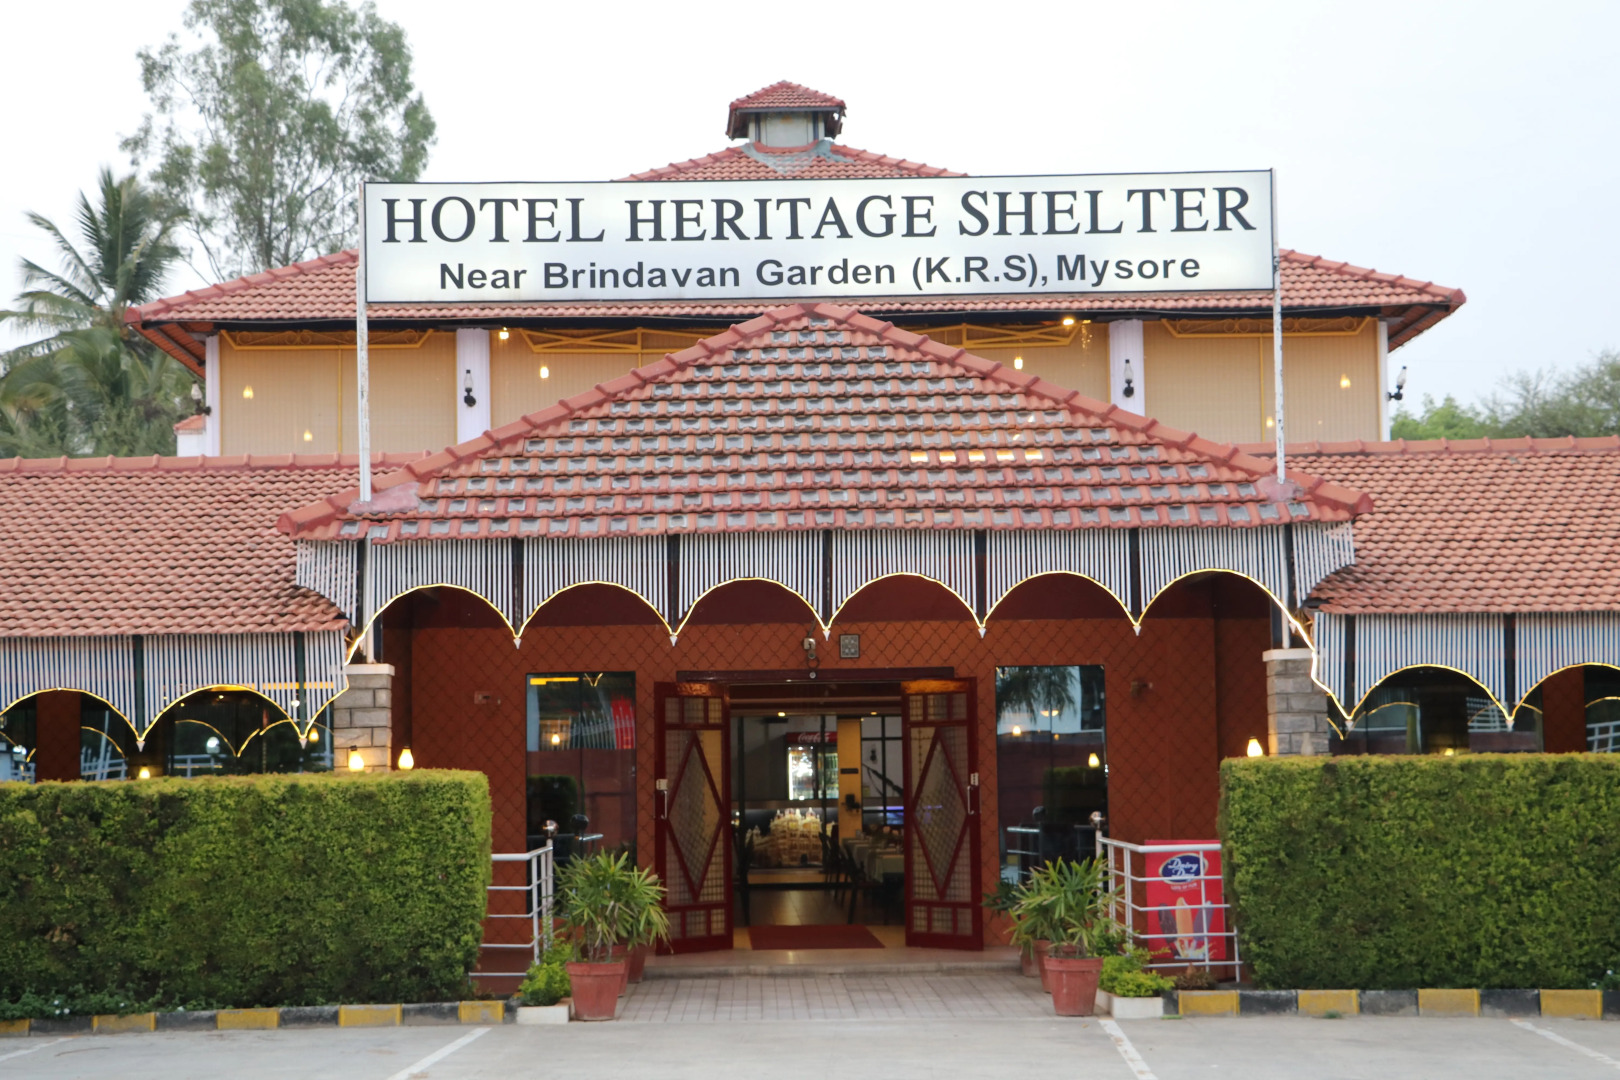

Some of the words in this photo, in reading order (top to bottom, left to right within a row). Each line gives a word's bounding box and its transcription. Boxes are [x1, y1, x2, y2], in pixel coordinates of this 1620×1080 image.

[382, 197, 604, 242] HOTEL
[625, 195, 936, 241] HERITAGE
[959, 188, 1256, 236] SHELTER
[441, 263, 526, 289] Near
[544, 261, 739, 288] Brindavan
[757, 258, 894, 286] Garden
[913, 254, 1047, 290] (K.R.S),
[1057, 254, 1200, 287] Mysore
[1168, 857, 1198, 872] Dairy
